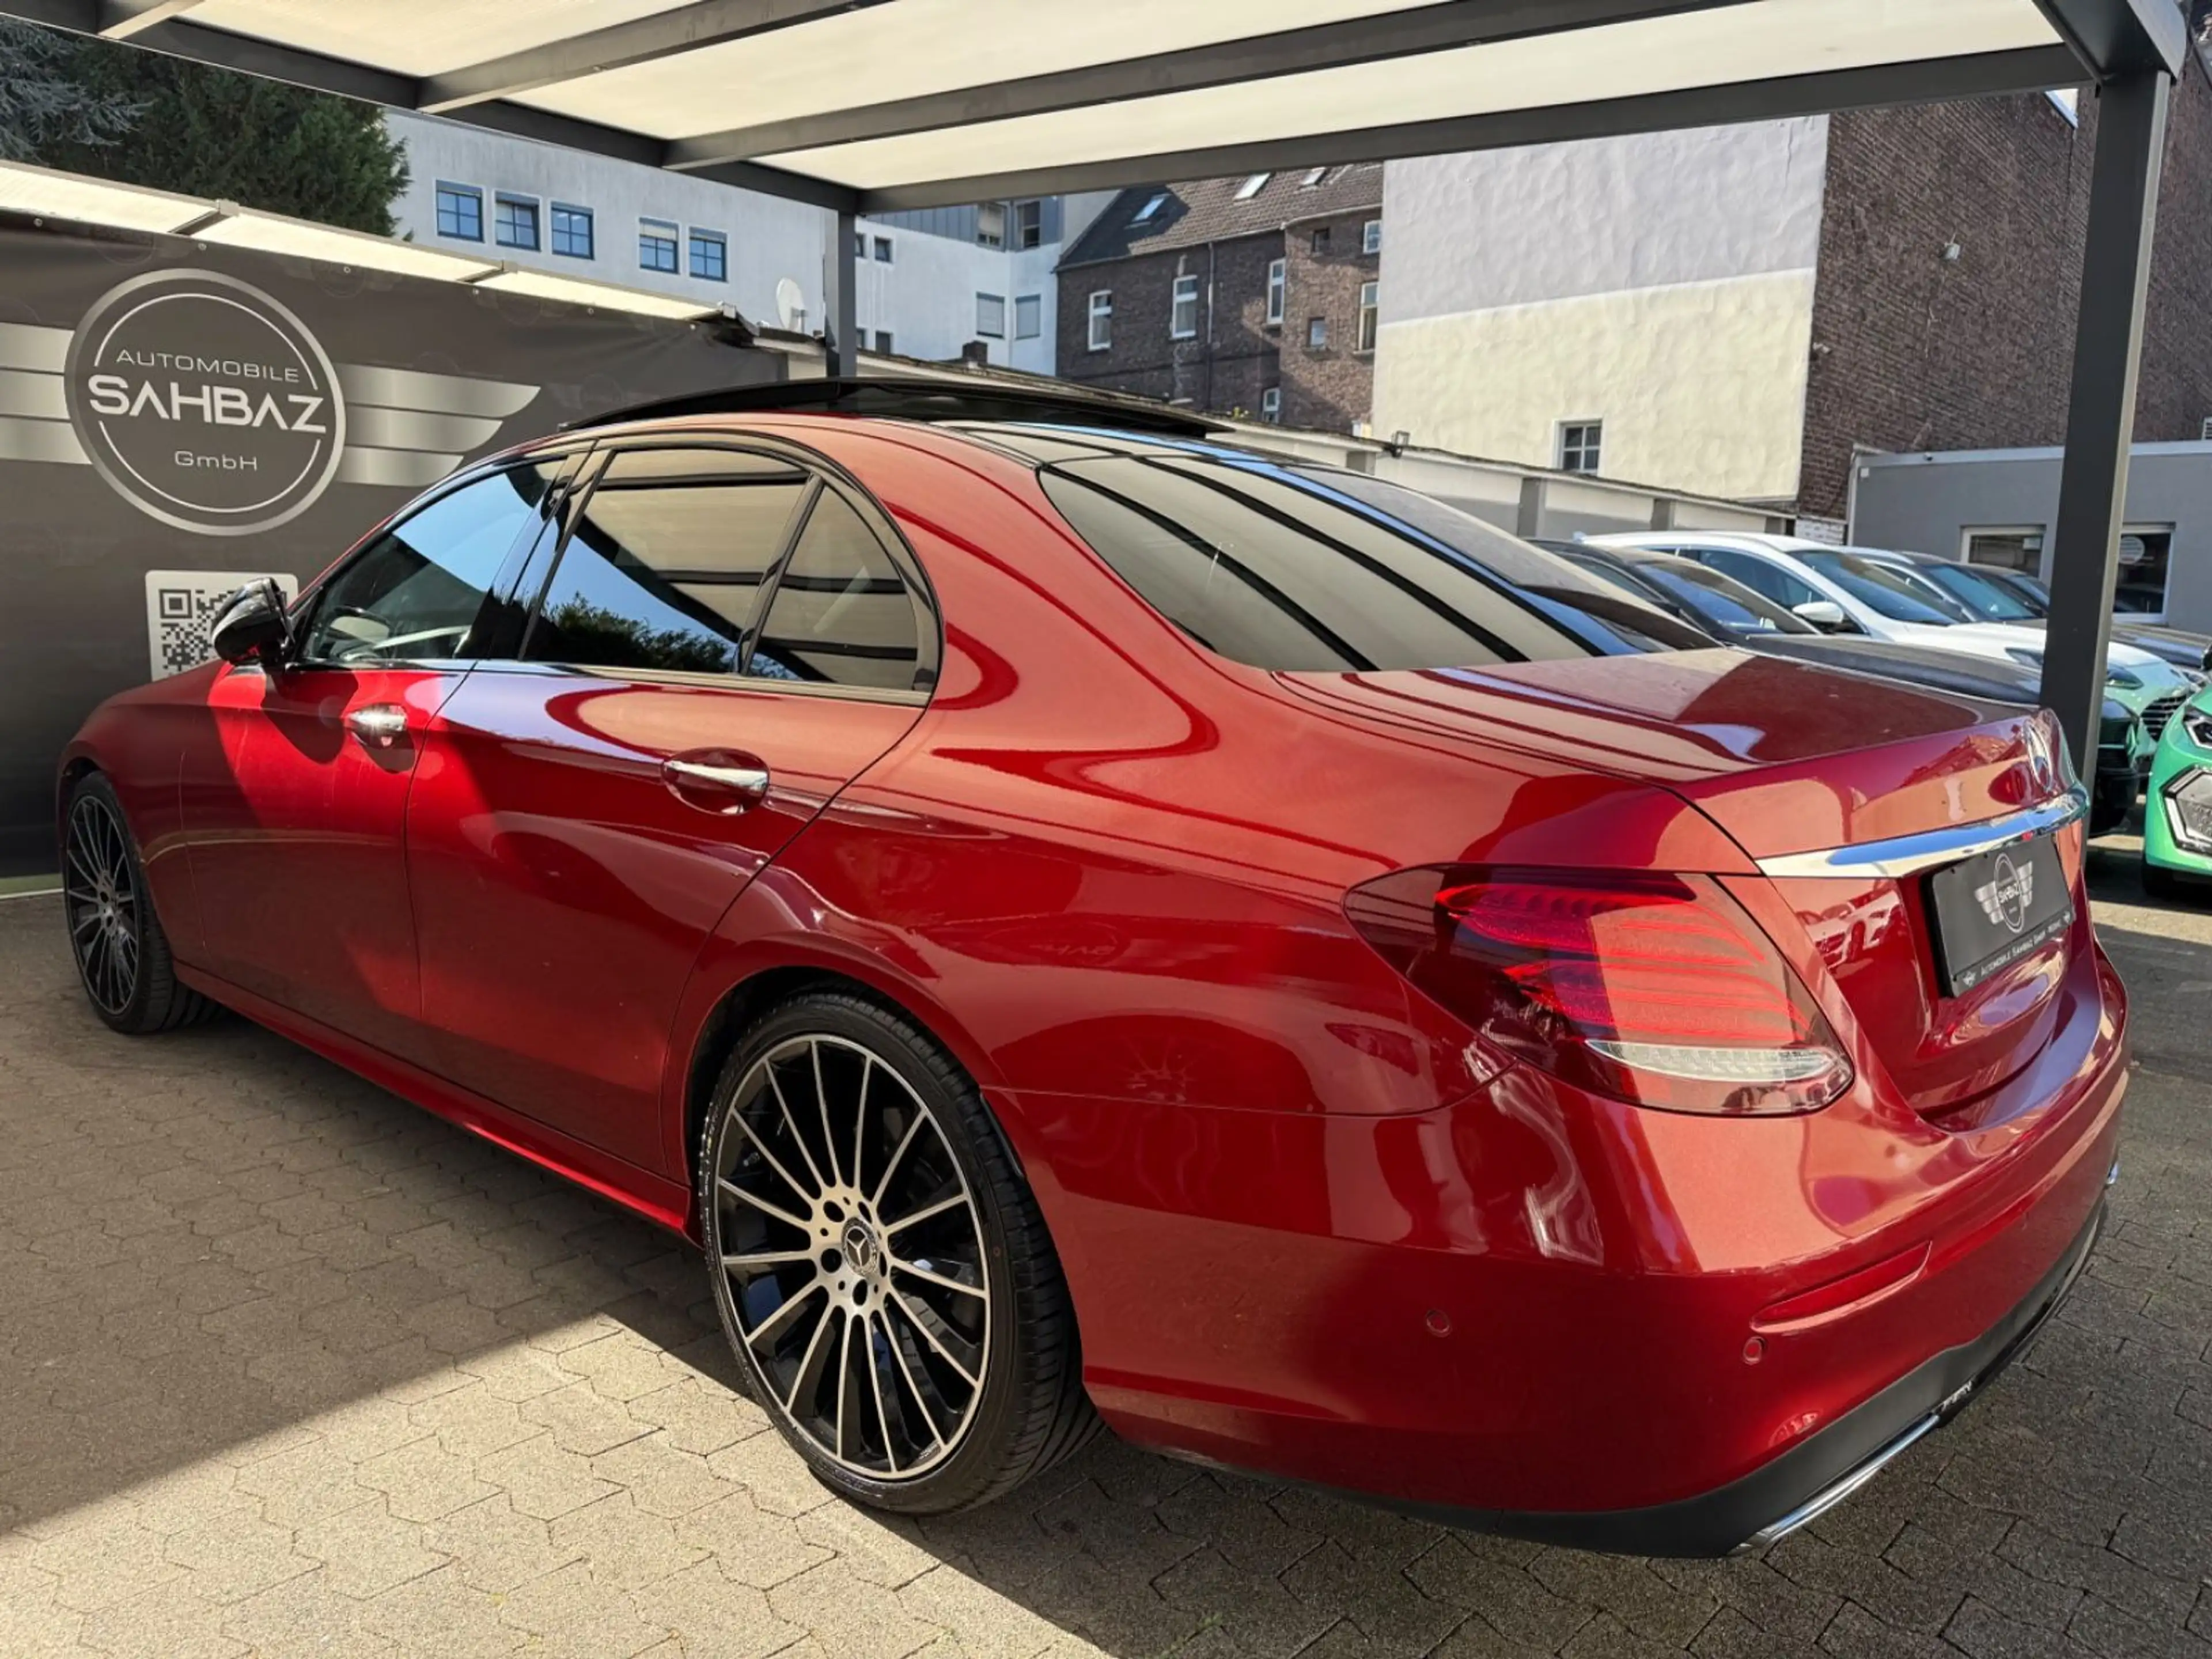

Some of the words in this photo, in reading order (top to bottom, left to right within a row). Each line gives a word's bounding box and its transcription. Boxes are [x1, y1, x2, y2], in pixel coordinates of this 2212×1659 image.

[116, 349, 299, 382] AUTOMOBILE
[88, 374, 327, 434] SAHBAZ
[175, 450, 257, 471] GmbH
